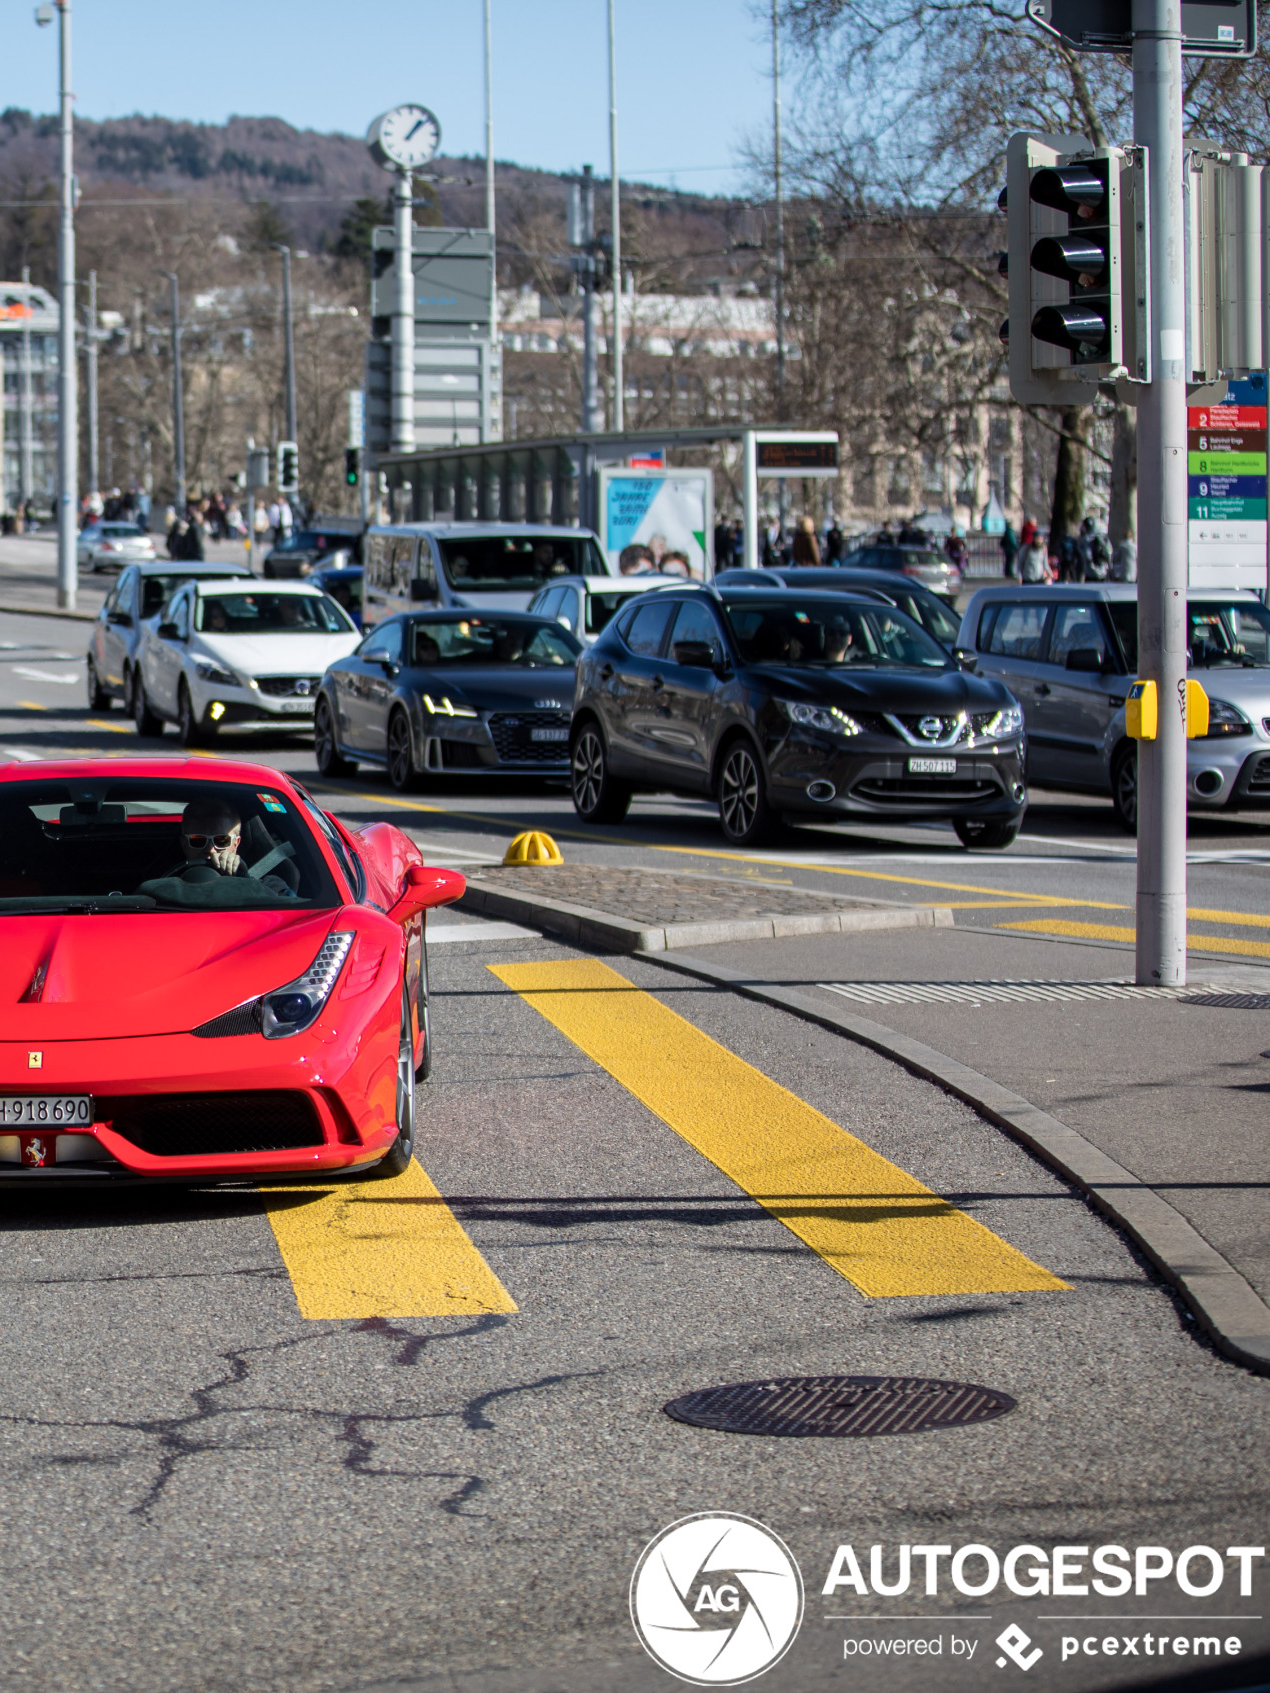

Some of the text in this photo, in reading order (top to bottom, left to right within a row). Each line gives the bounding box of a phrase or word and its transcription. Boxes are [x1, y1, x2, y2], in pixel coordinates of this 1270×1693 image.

[1199, 413, 1208, 427] 2
[1199, 436, 1208, 450] 5
[1199, 461, 1207, 472] 8
[1199, 482, 1208, 496] 9
[1196, 505, 1208, 519] 11
